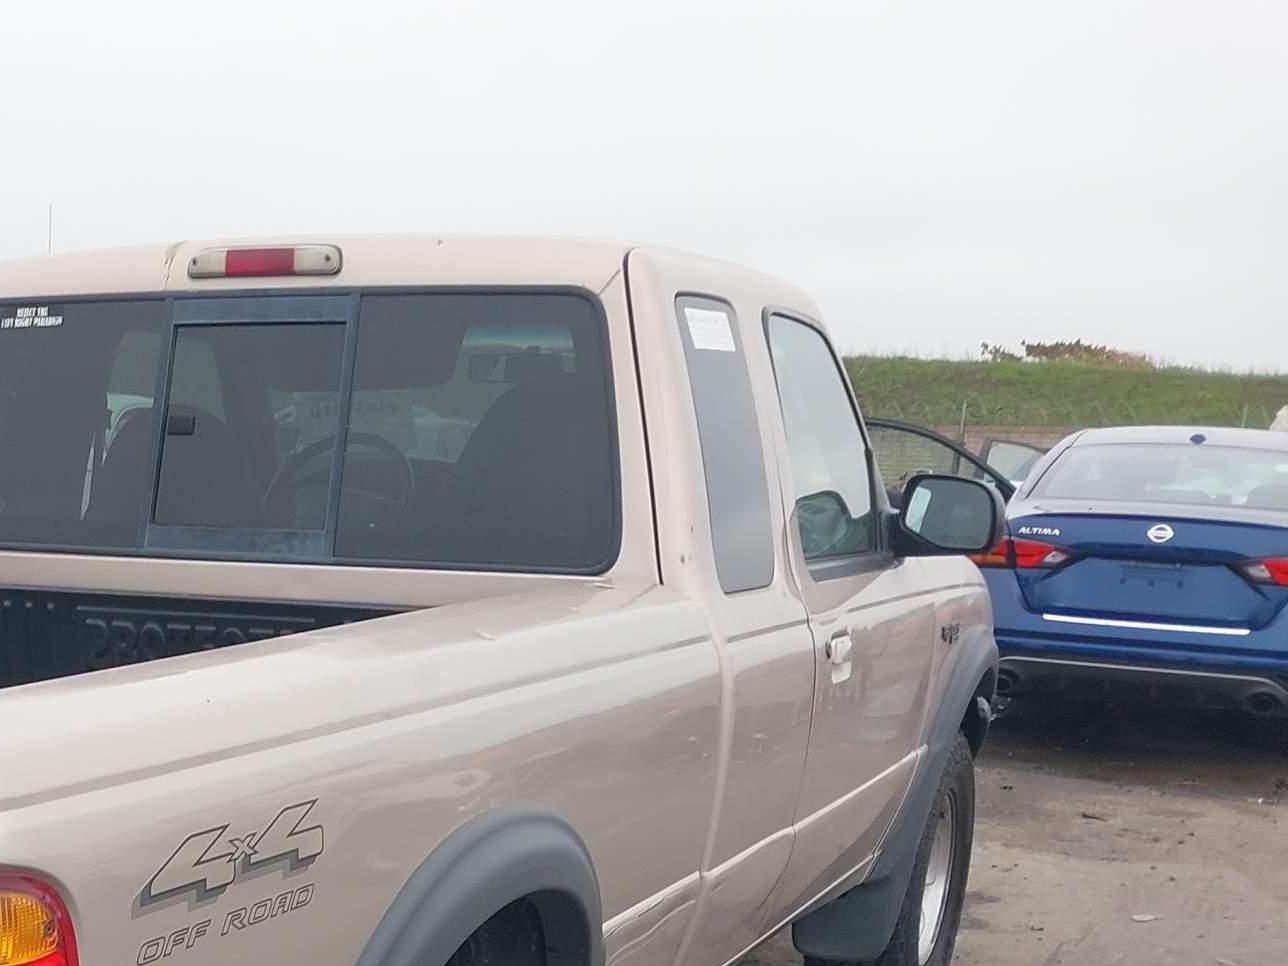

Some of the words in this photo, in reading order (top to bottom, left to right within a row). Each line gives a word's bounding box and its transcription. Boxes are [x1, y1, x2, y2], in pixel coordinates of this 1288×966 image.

[1018, 526, 1060, 537] ALTIMA
[137, 919, 212, 966] OFF
[220, 882, 315, 937] ROAD
